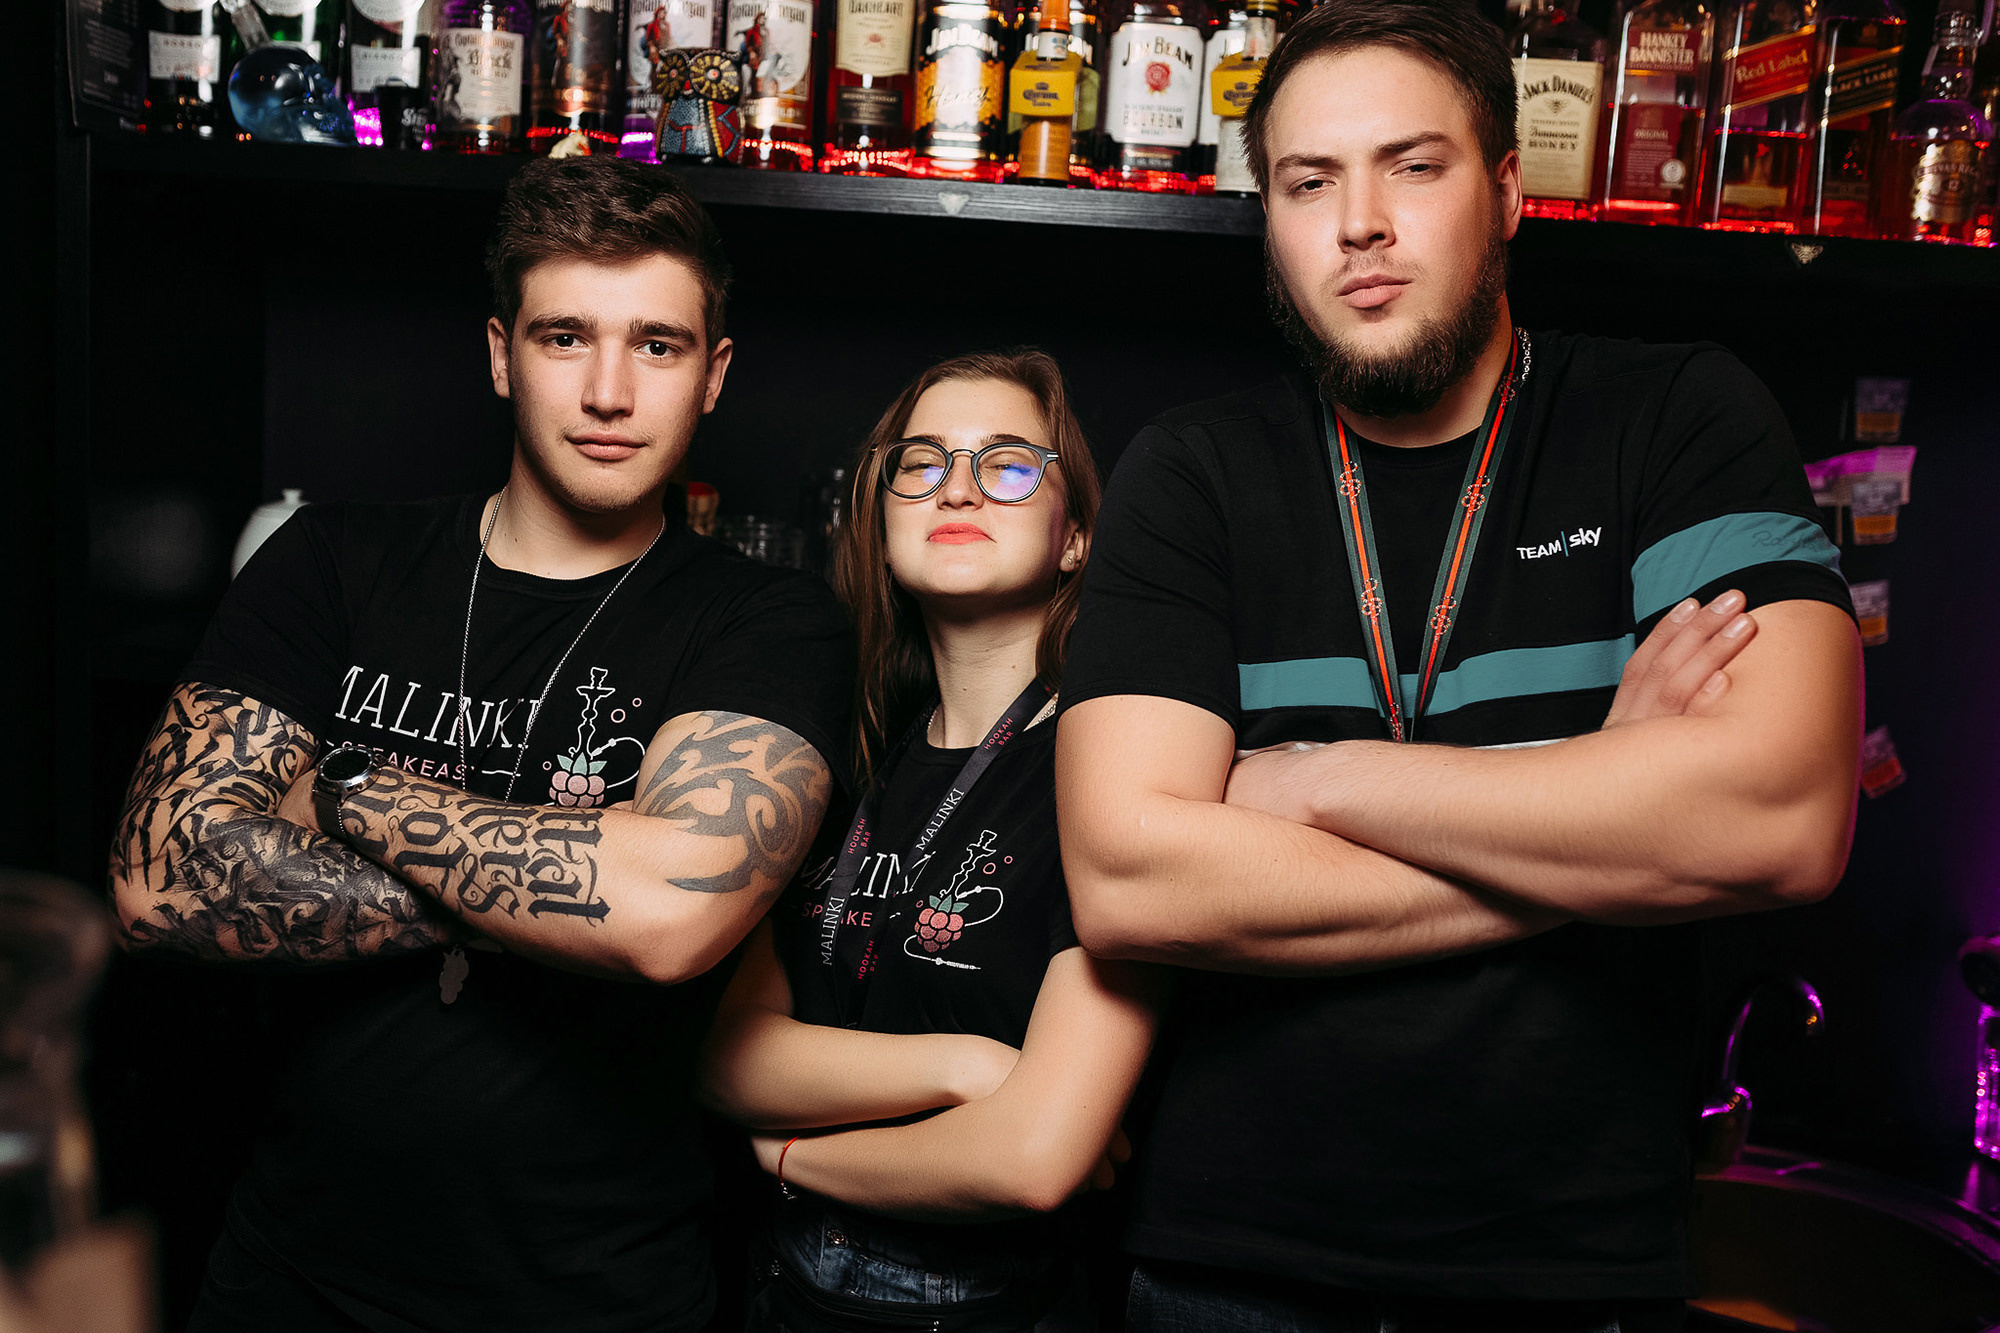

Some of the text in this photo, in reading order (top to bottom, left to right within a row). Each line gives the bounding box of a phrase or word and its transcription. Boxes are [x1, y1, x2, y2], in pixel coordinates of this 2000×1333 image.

[1640, 31, 1688, 48] HANKEY
[1629, 46, 1694, 64] BANNISTER
[1736, 48, 1809, 84] Red Label
[1523, 80, 1550, 101] JACK
[1528, 139, 1578, 151] HONEY
[1516, 540, 1562, 559] TEAM
[984, 718, 1013, 750] HOOKAH
[998, 730, 1014, 747] BAR
[342, 741, 475, 780] AKEAS
[915, 788, 965, 851] MALINKI
[848, 818, 867, 854] HOOKAH
[860, 831, 871, 848] BAR
[820, 896, 845, 966] MALINKI
[857, 940, 875, 980] HOOKAH
